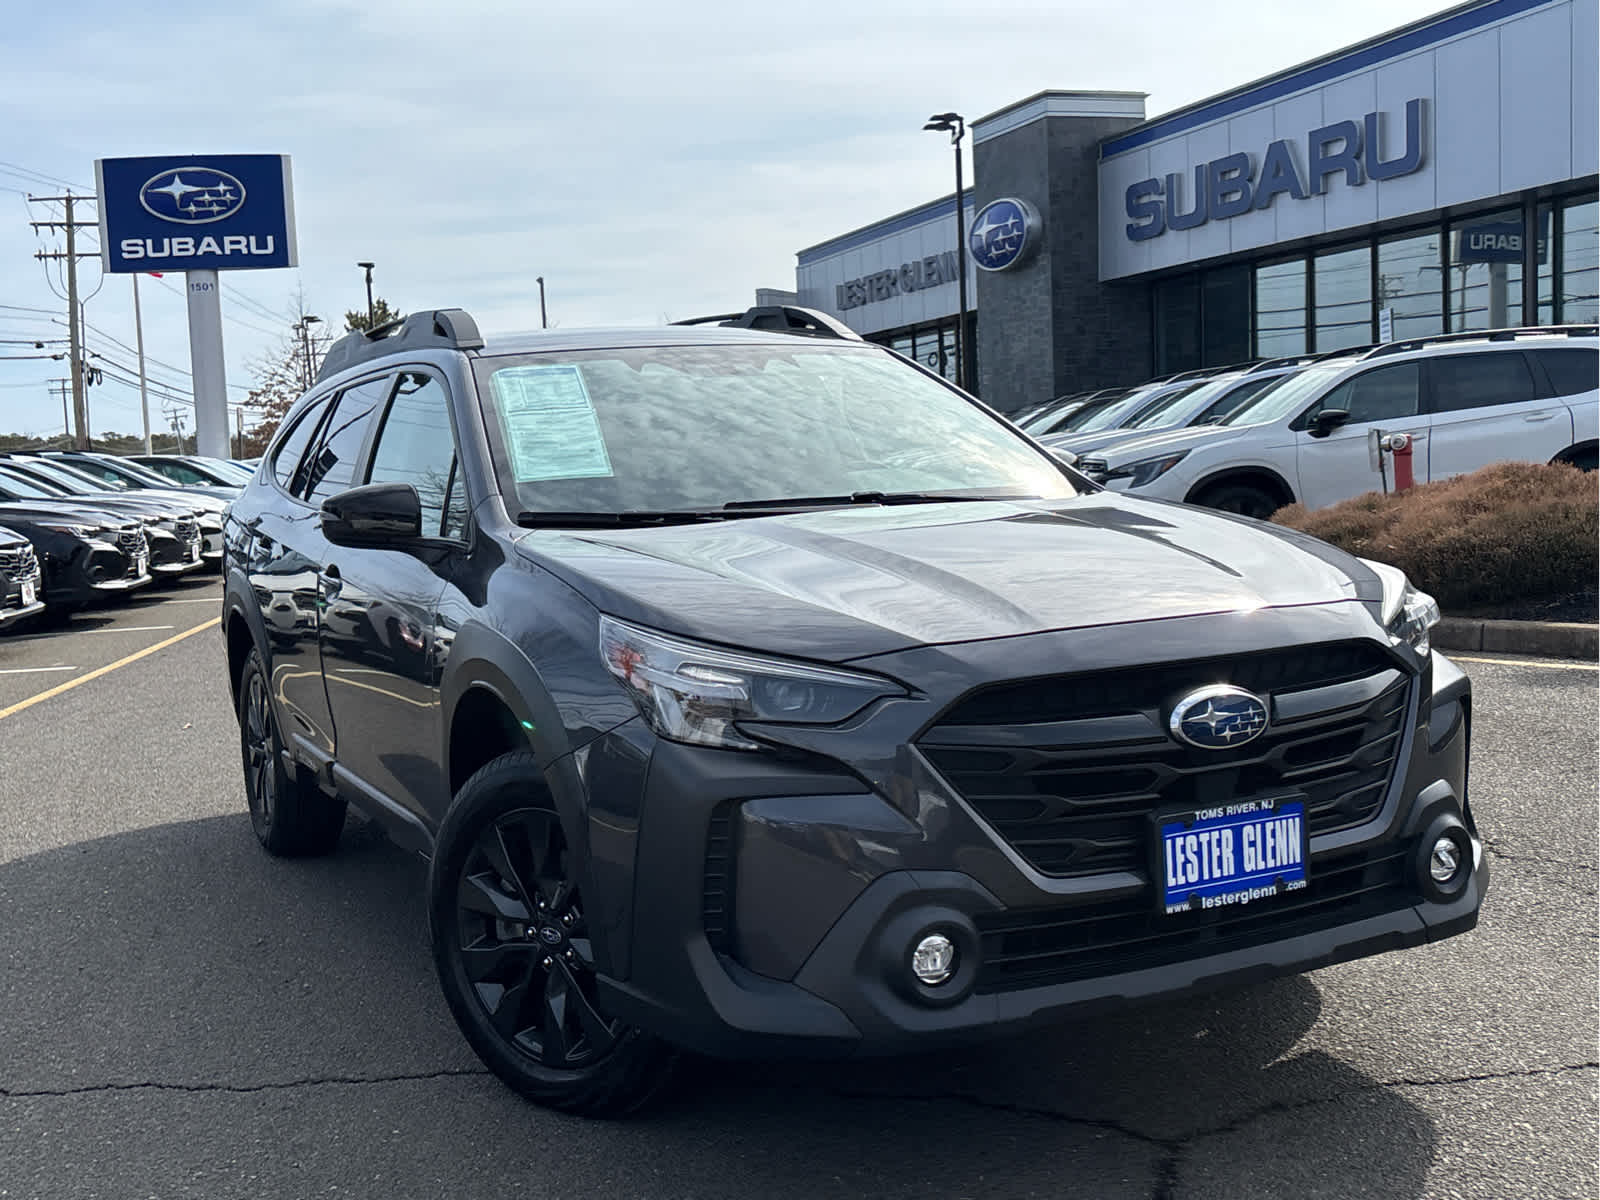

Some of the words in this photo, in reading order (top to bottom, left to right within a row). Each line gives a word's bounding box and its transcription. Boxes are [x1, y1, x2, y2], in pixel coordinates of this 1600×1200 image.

[1125, 98, 1429, 242] SUBARU
[120, 235, 275, 259] SUBARU
[190, 282, 214, 292] 1501
[836, 269, 899, 311] LESTER
[1194, 810, 1224, 821] TOMS
[1261, 799, 1274, 810] NJ
[1165, 829, 1235, 887] LESTER
[1242, 817, 1301, 872] GLENN
[1166, 903, 1192, 914] www.
[1202, 886, 1277, 909] lesterglenn
